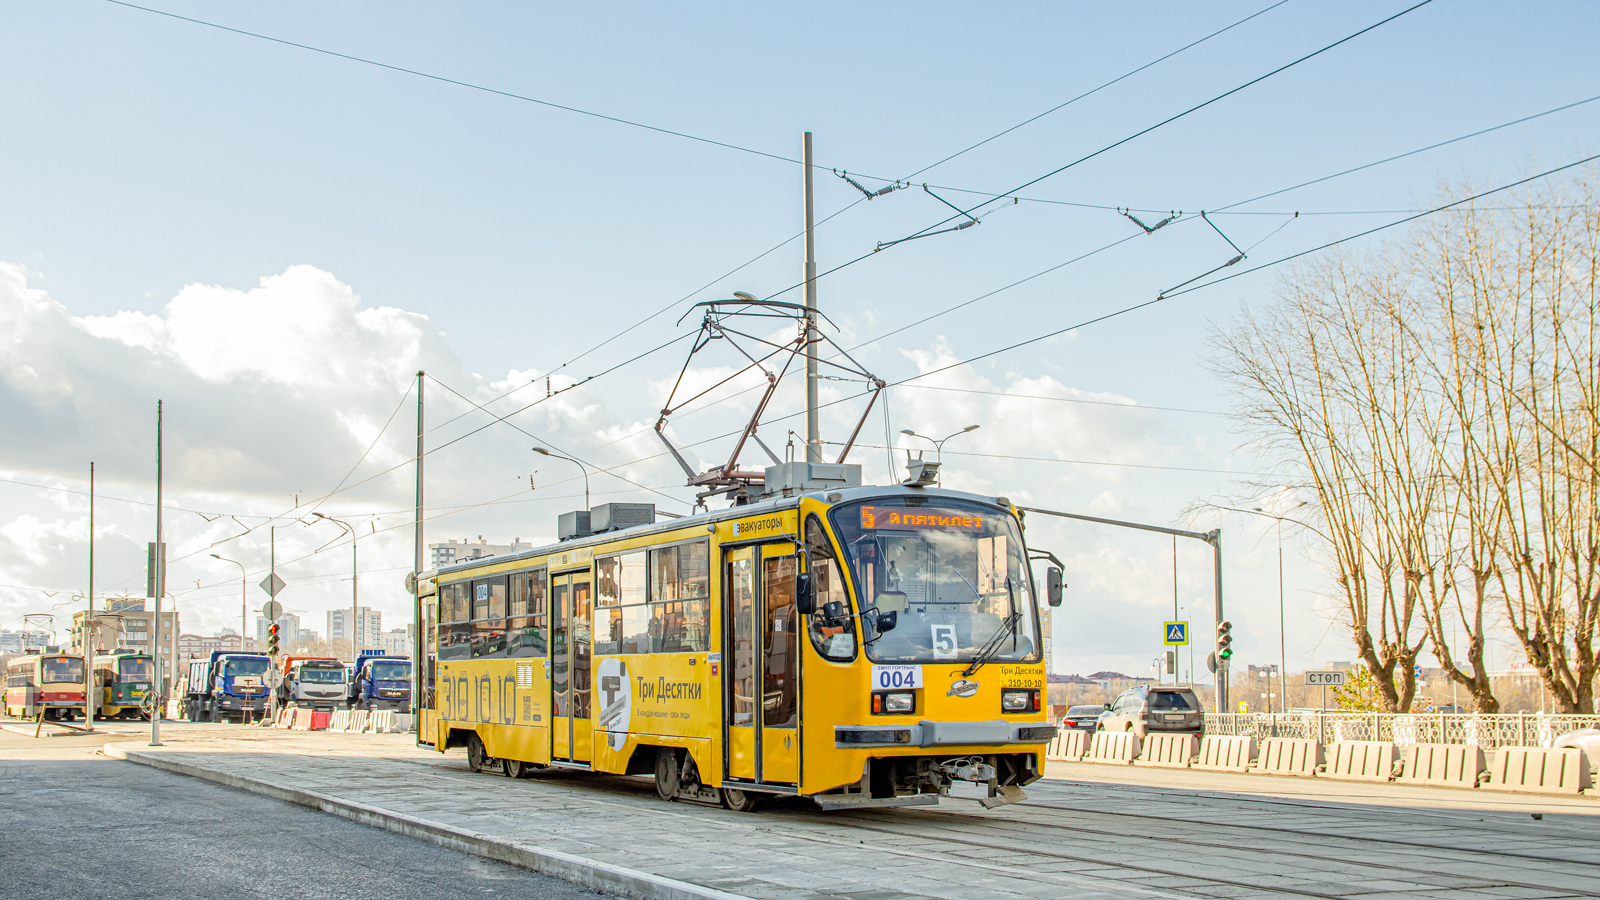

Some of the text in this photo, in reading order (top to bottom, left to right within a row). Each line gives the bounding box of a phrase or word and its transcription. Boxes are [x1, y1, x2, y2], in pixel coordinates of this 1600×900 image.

[862, 506, 876, 529] 5
[903, 514, 984, 527] пятилет
[736, 517, 783, 534] эвакуаторы
[478, 586, 487, 599] 004
[936, 627, 954, 654] 5
[1000, 666, 1043, 675] Три Десятки
[1309, 673, 1341, 683] СТОП
[879, 671, 915, 688] 004
[1008, 679, 1042, 688] 310-10-10
[637, 676, 702, 704] Три Десятки
